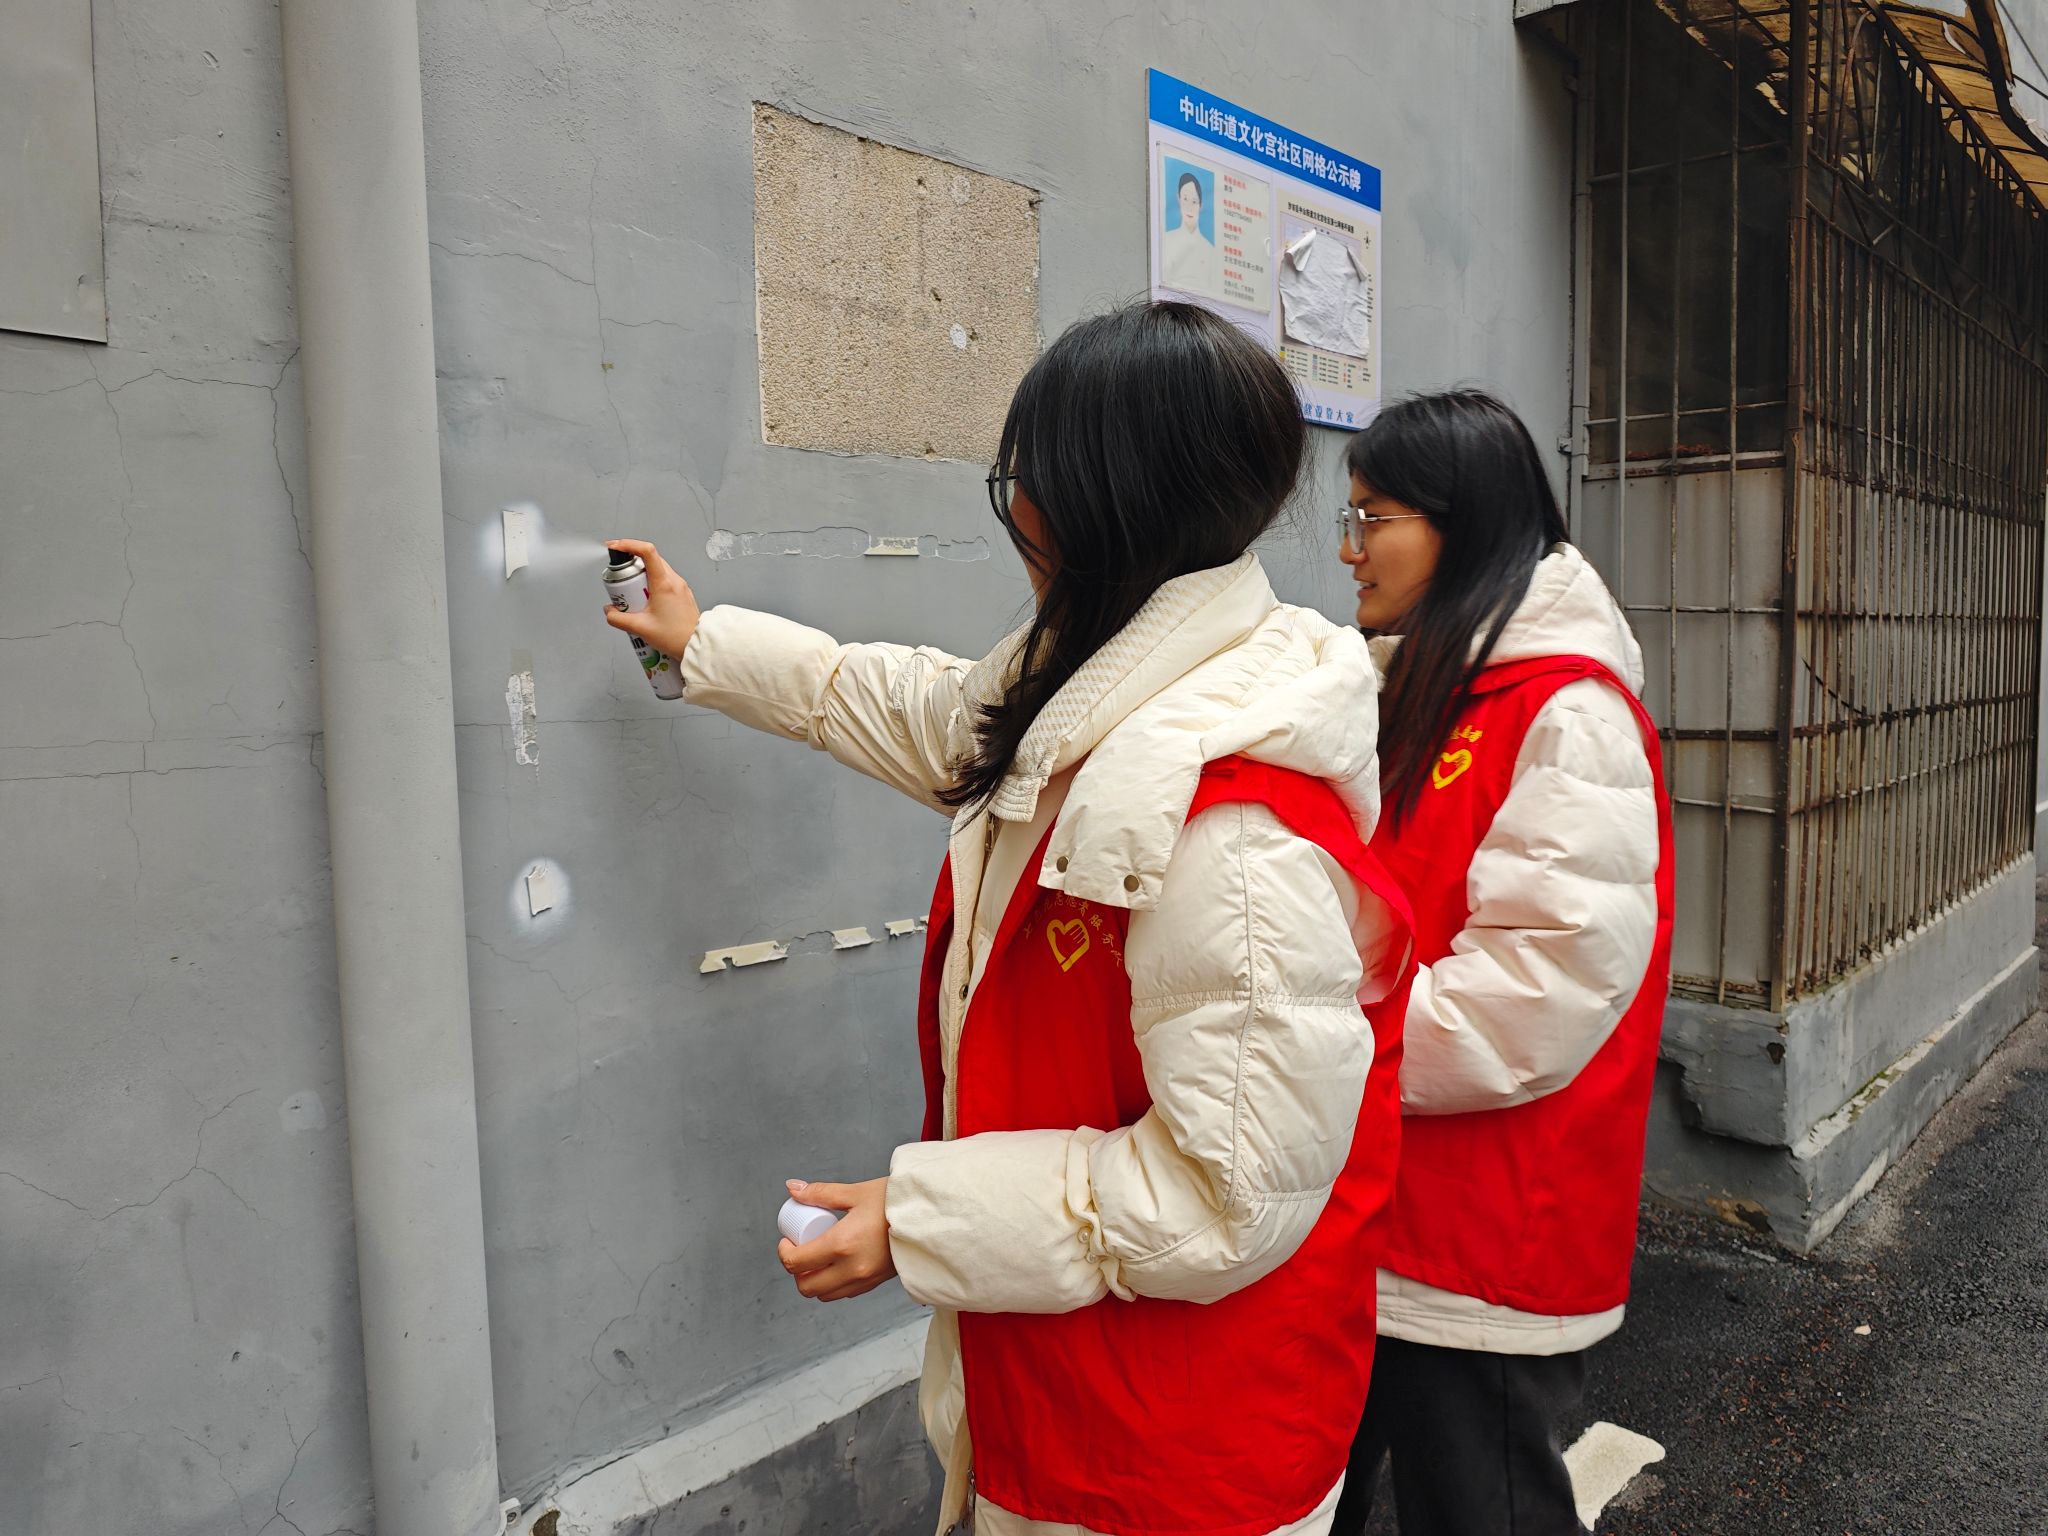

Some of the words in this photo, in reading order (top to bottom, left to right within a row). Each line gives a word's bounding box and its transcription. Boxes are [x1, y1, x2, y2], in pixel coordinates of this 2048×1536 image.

[1179, 96, 1362, 192] 中山街道文化宫社区网格公示牌
